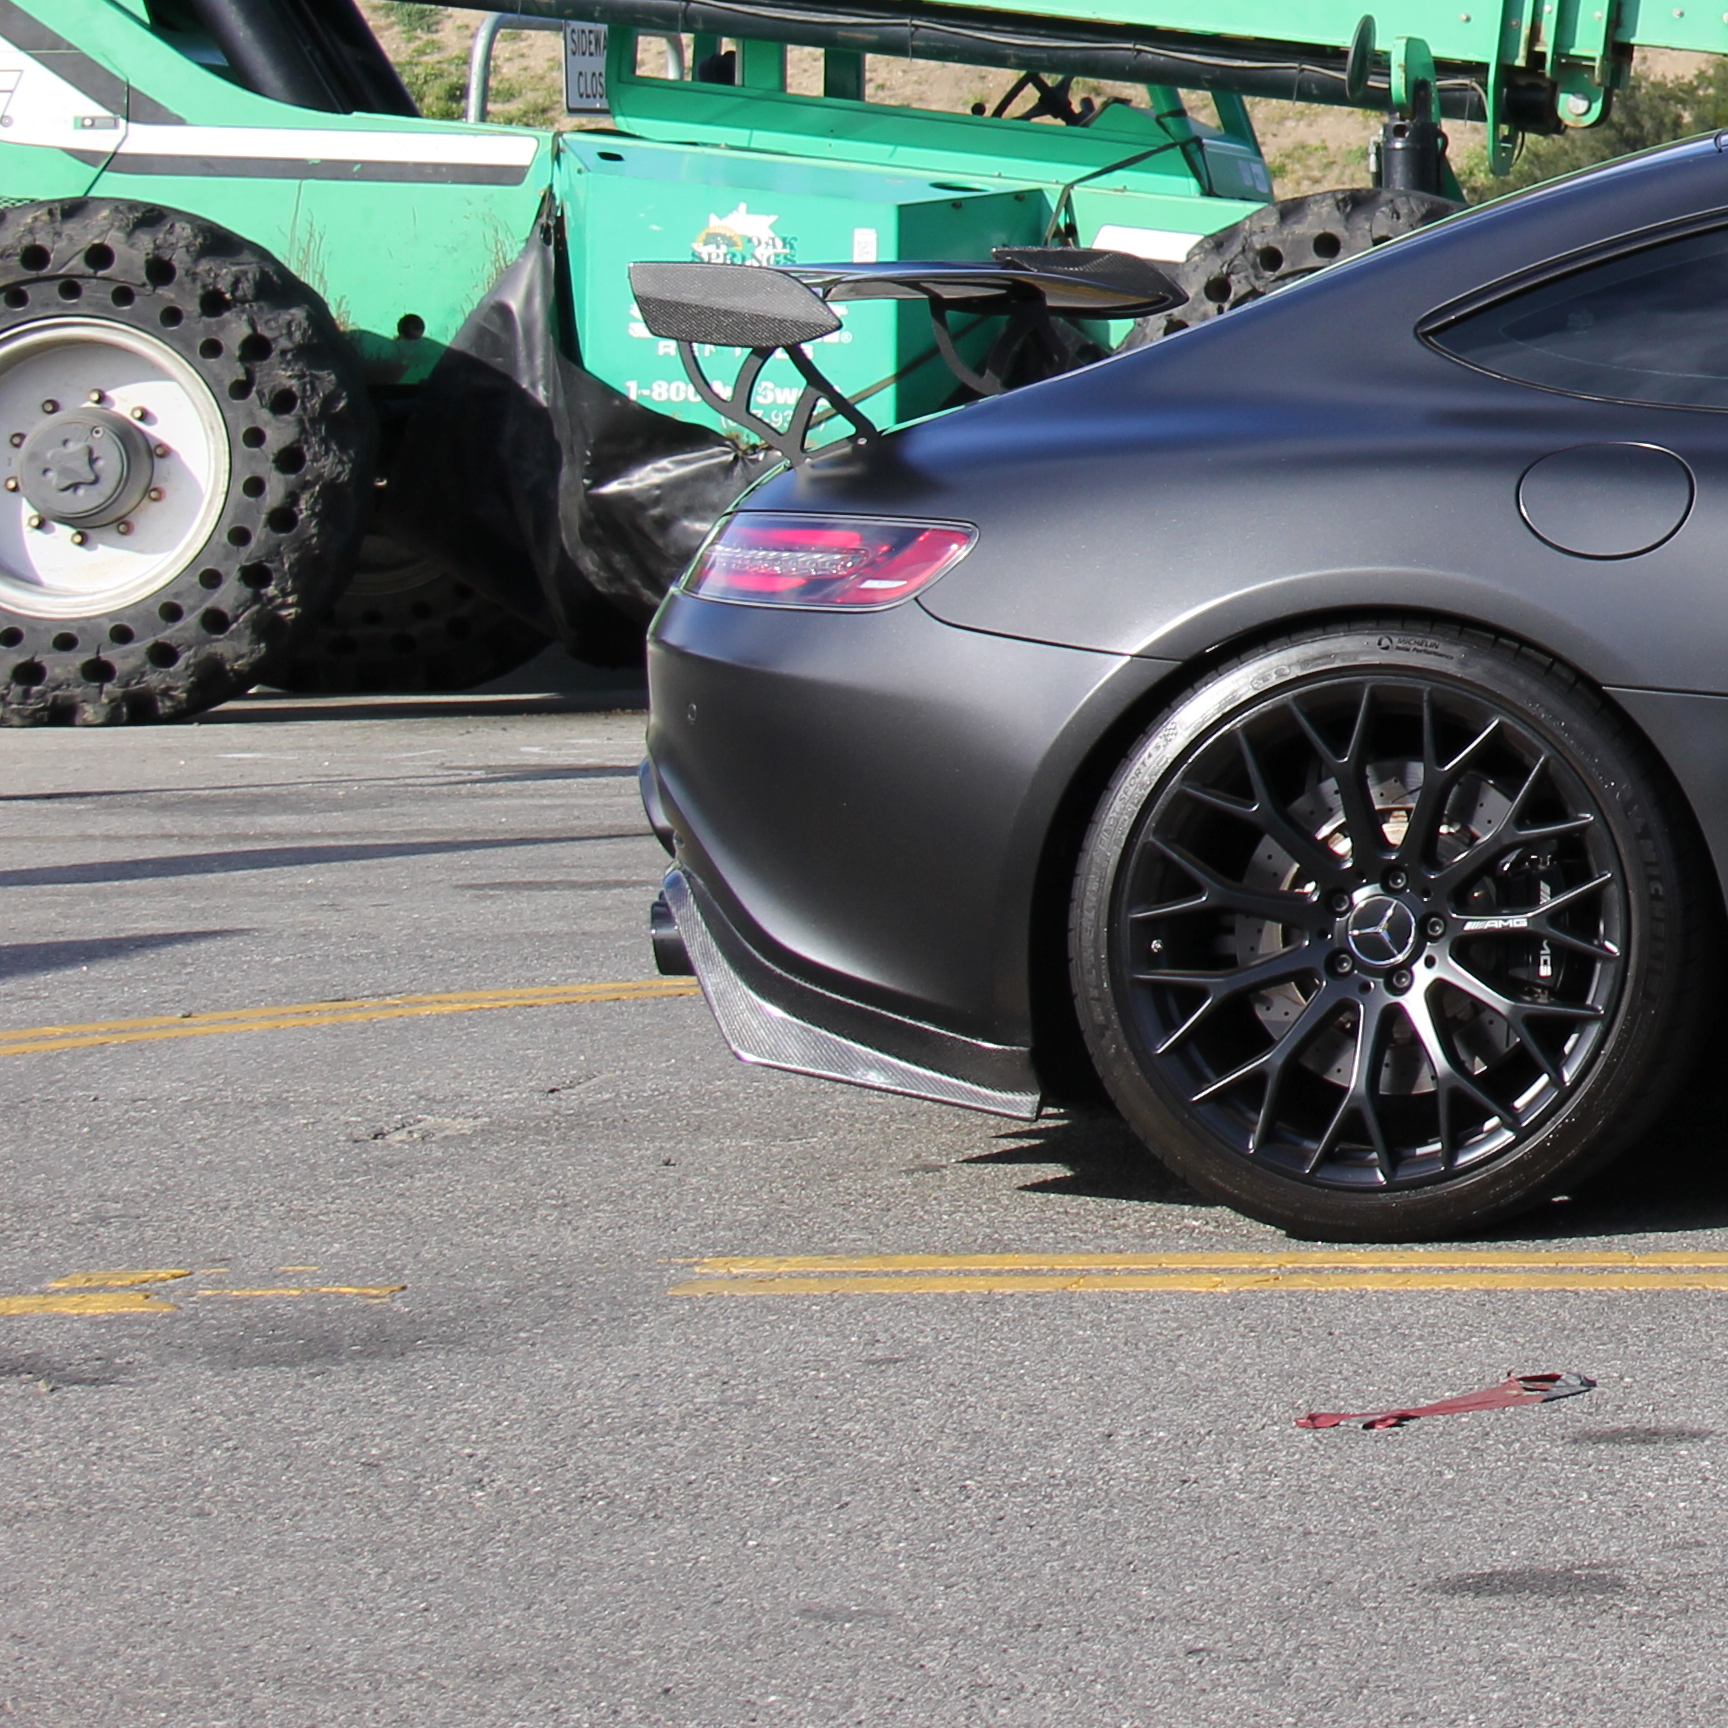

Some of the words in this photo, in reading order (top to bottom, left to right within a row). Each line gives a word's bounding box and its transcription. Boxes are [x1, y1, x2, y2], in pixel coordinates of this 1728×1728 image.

[577, 71, 608, 99] CLOS
[690, 251, 798, 267] SPRINGS
[1118, 759, 1149, 804] SPORT
[1484, 918, 1528, 929] AMG
